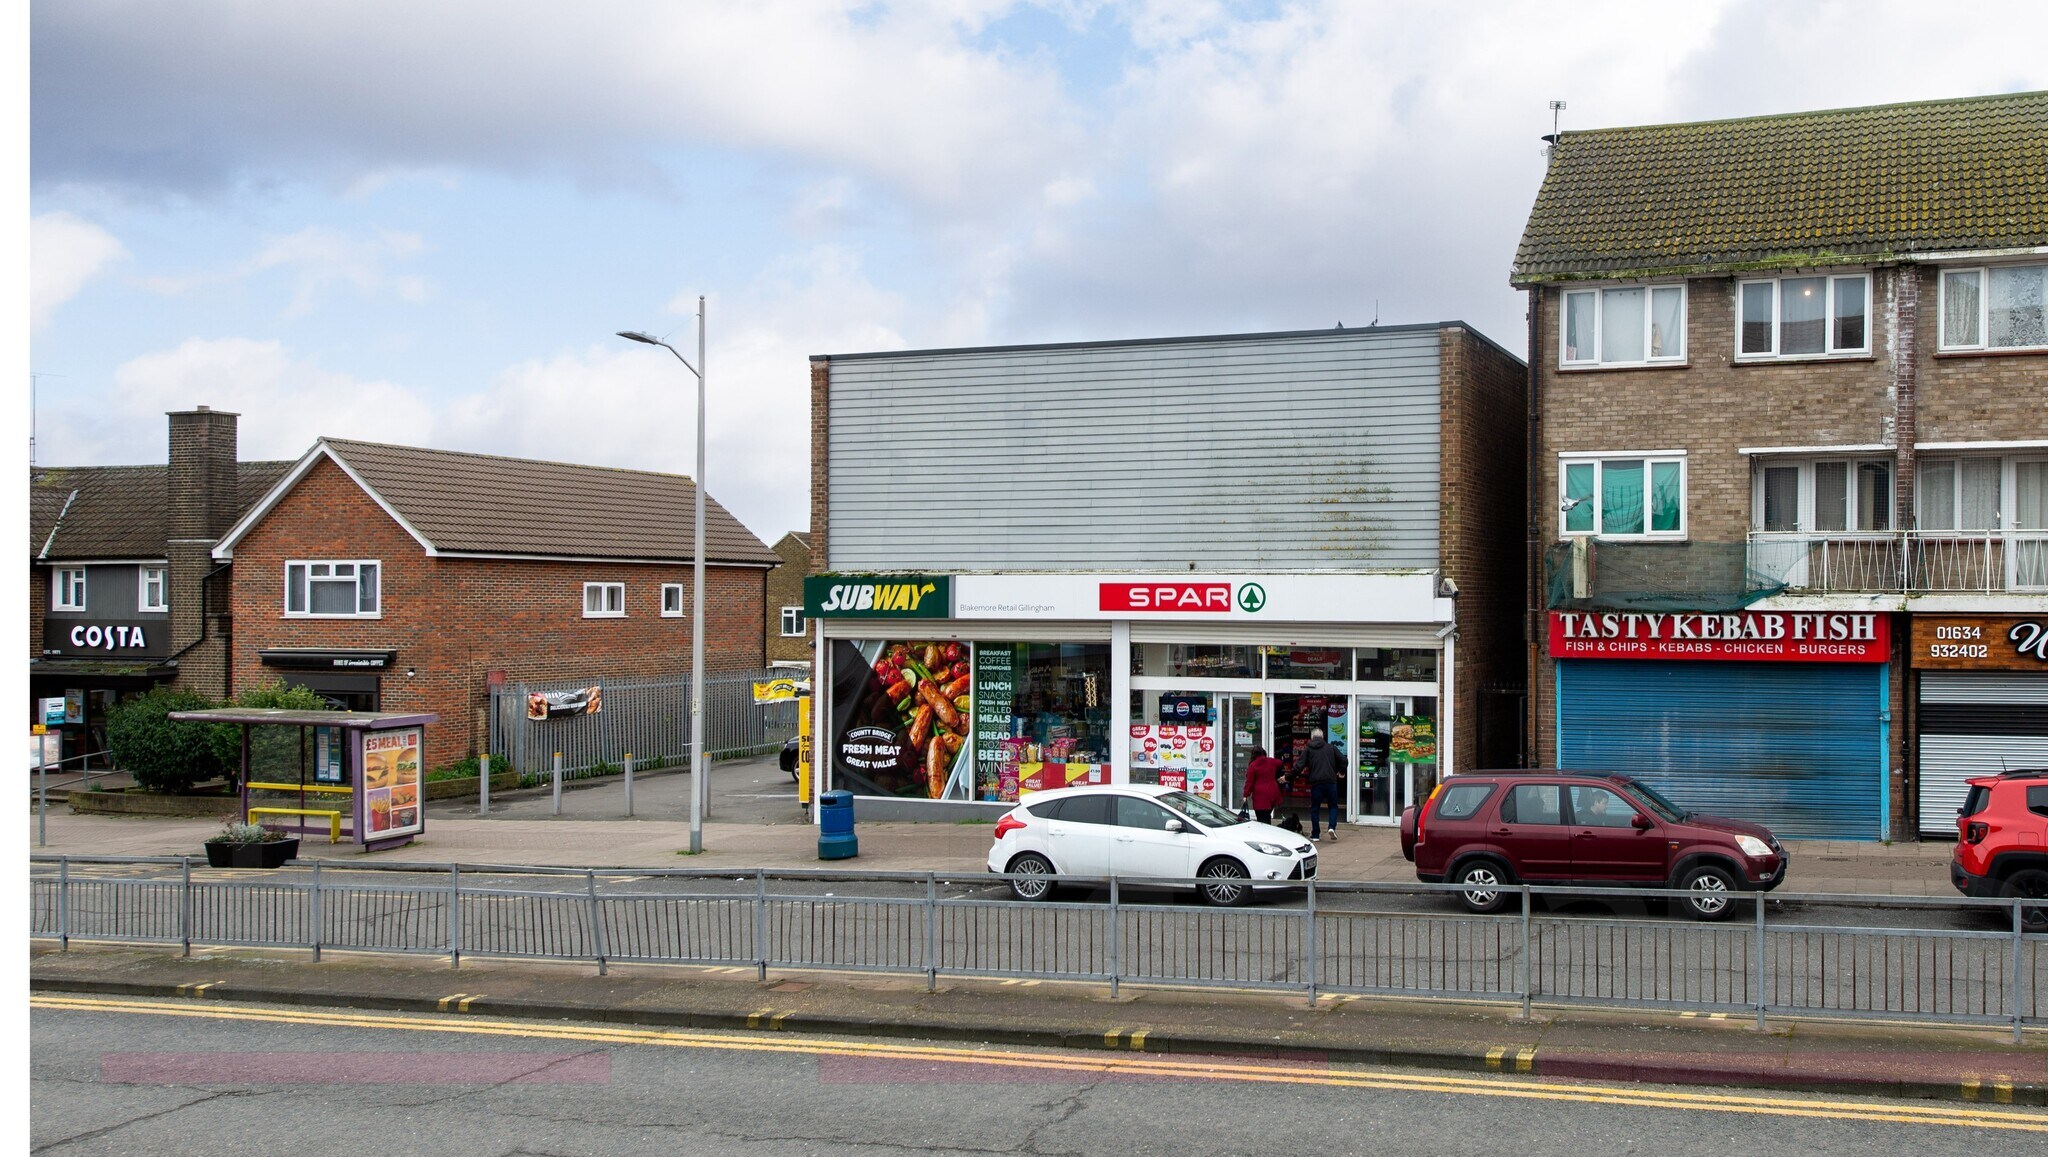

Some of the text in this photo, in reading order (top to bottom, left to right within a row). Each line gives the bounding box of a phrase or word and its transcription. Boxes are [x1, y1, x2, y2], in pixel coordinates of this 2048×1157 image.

[821, 582, 935, 611] SUBWAY
[1129, 587, 1228, 607] SPAR
[960, 604, 1055, 613] Blakemore Retail Gillingham
[1559, 612, 1877, 640] TASTY KEBAB FISH
[71, 625, 146, 651] COSTA
[1936, 626, 1981, 640] 01634
[1565, 642, 1593, 651] FISH
[1597, 642, 1605, 651] &
[1609, 642, 1647, 652] CHIPS
[1659, 643, 1712, 653] KEBABS
[1724, 643, 1783, 653] CHICKEN
[1799, 644, 1866, 655] BURGERS
[1930, 644, 1987, 658] 932402
[979, 657, 1011, 665] COFFEE
[979, 671, 1012, 681] DRINKS
[979, 681, 1012, 691] LUNCH
[979, 691, 1012, 700] SNACKS
[979, 706, 1012, 714] CHILLED
[979, 714, 1011, 723] MEALS
[979, 723, 1011, 731] DESSERTS
[850, 729, 892, 740] COUNTY BRIDGE
[979, 731, 1010, 740] BREAD
[366, 738, 378, 750] £5
[378, 735, 402, 750] MEAL
[979, 740, 1010, 750] FROZEN
[842, 743, 902, 756] FRESH MEAT
[978, 749, 1010, 762] BEER
[846, 755, 897, 769] GREAT VALUE
[979, 762, 1010, 773] WINE
